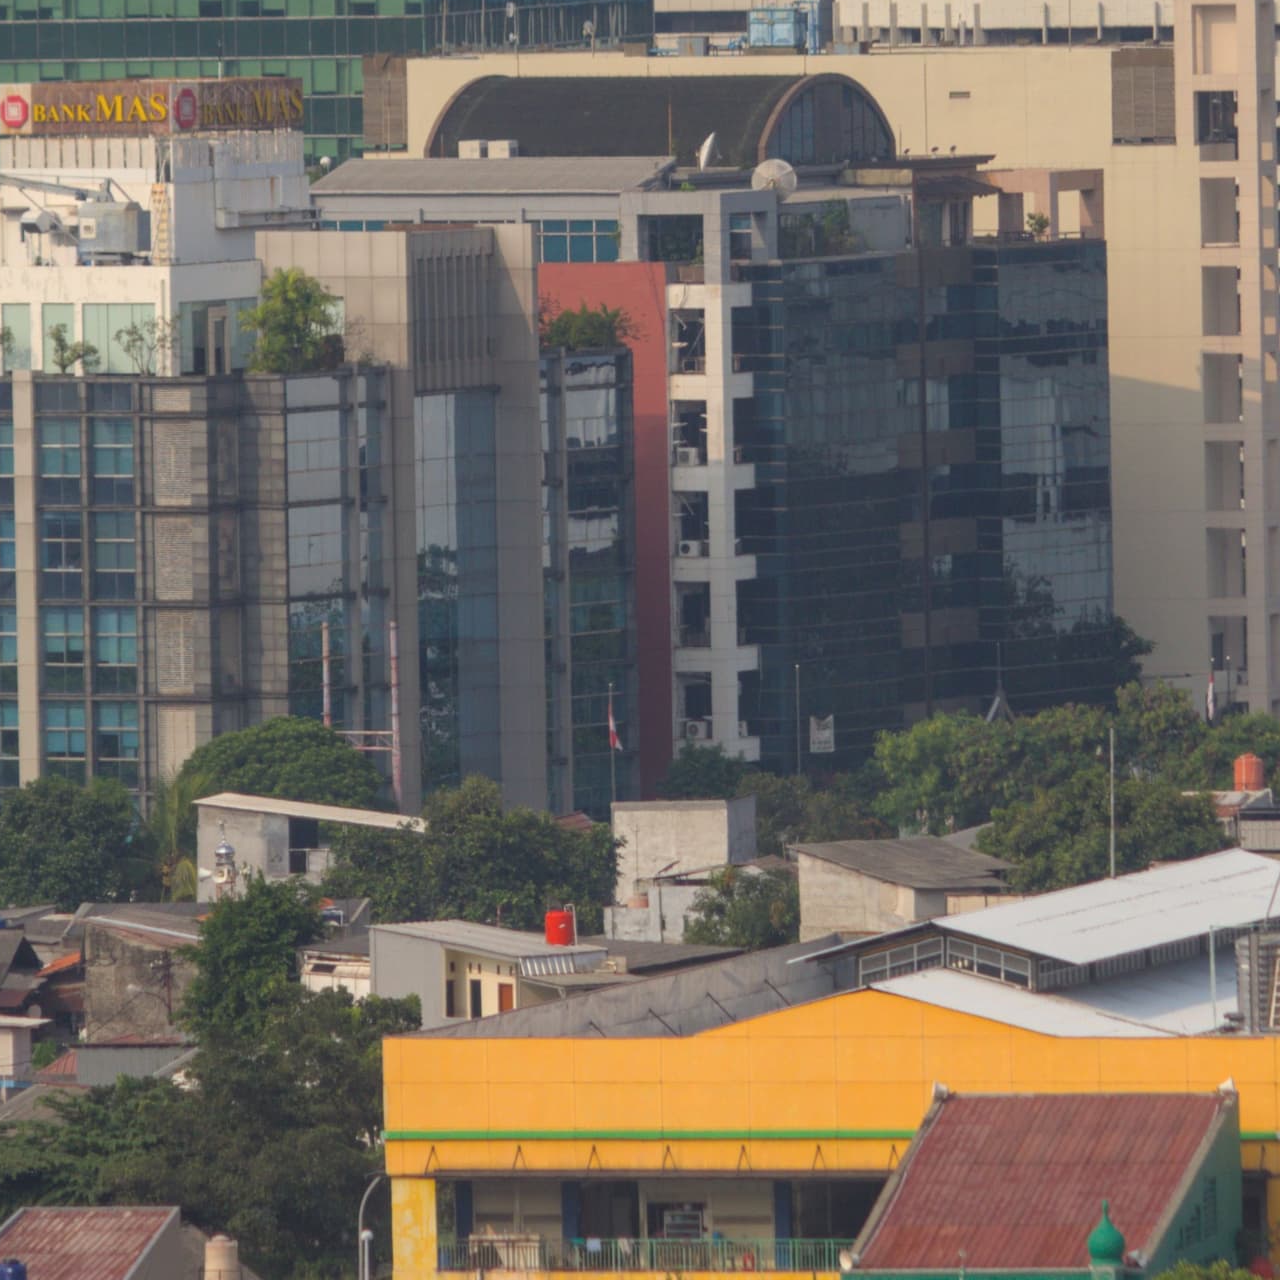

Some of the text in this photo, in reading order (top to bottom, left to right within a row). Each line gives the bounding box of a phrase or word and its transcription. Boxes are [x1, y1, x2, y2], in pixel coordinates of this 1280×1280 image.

[33, 93, 168, 124] BANK MAS
[253, 88, 304, 122] MAS
